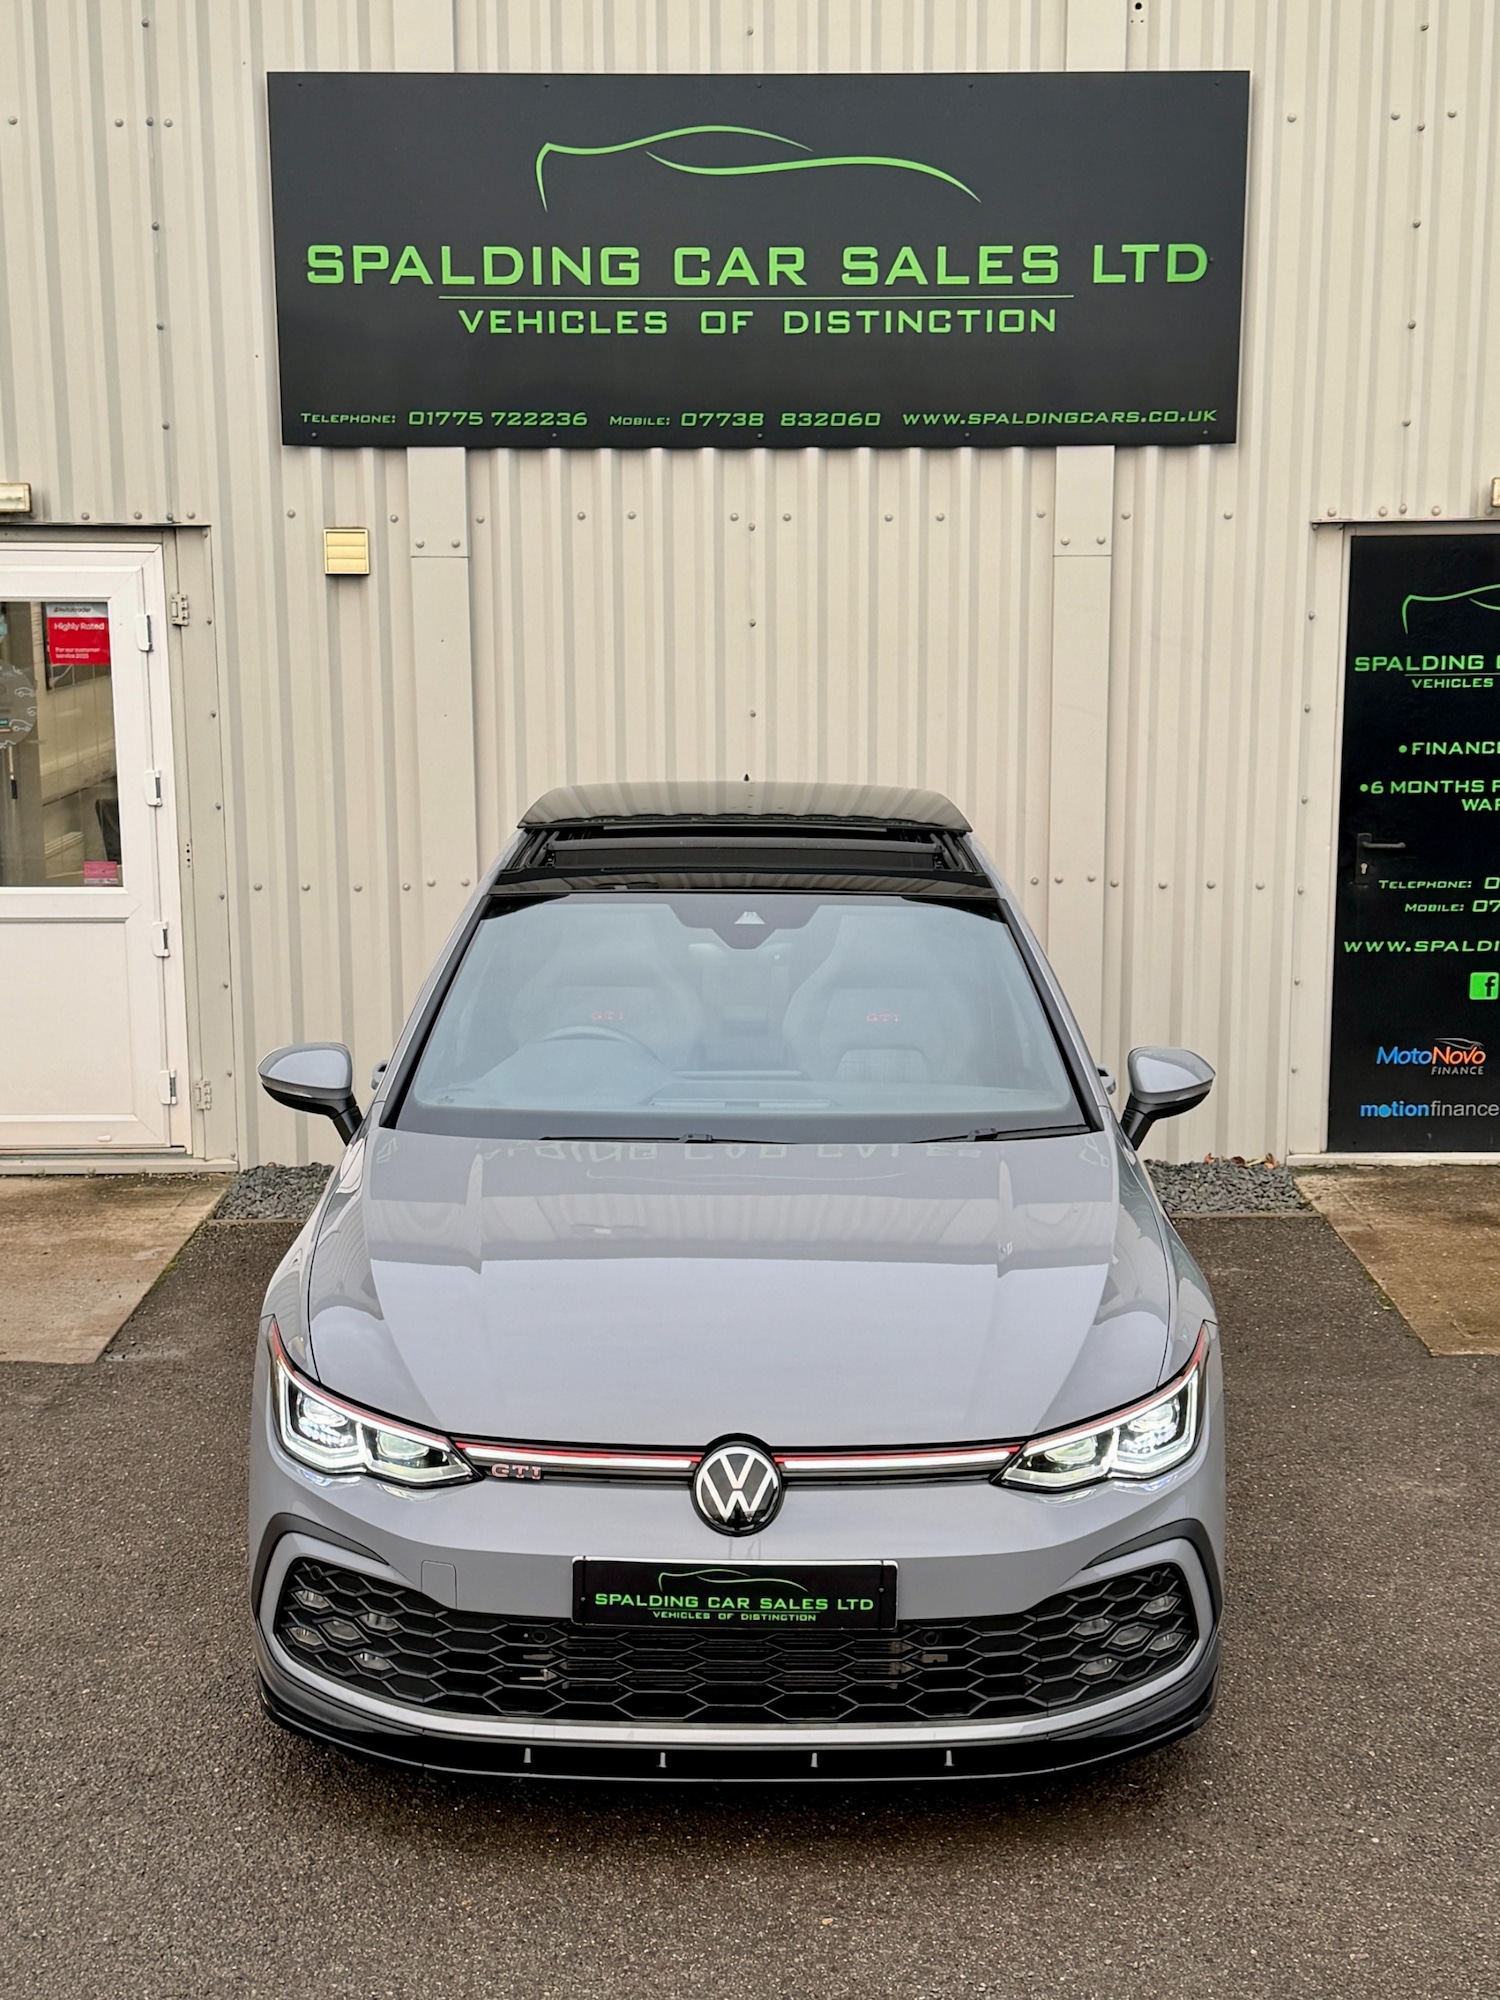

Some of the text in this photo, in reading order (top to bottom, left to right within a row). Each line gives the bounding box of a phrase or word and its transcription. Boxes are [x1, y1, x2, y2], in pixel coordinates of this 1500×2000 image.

[306, 242, 1209, 287] SPALDING CAR SALES LTD
[458, 308, 1057, 336] VEHICLES OF DISTINCTION
[407, 410, 484, 427] 01775
[491, 410, 588, 428] 722236
[679, 411, 765, 428] 07738
[779, 411, 881, 428] 832060
[53, 621, 105, 632] Highly Rated
[1354, 654, 1485, 672] SPALDING
[1411, 678, 1494, 689] VEHICLES
[1411, 741, 1500, 755] FINANC
[1370, 780, 1385, 794] 6
[1390, 779, 1485, 794] MONTHS
[1375, 1045, 1487, 1066] MotoNovo
[1430, 1065, 1484, 1076] FINANCE
[490, 1462, 542, 1481] GTI
[594, 1592, 875, 1612] SPALDING CAR SALES LTD
[652, 1610, 817, 1623] VEHICLES OF DISTINCTION
